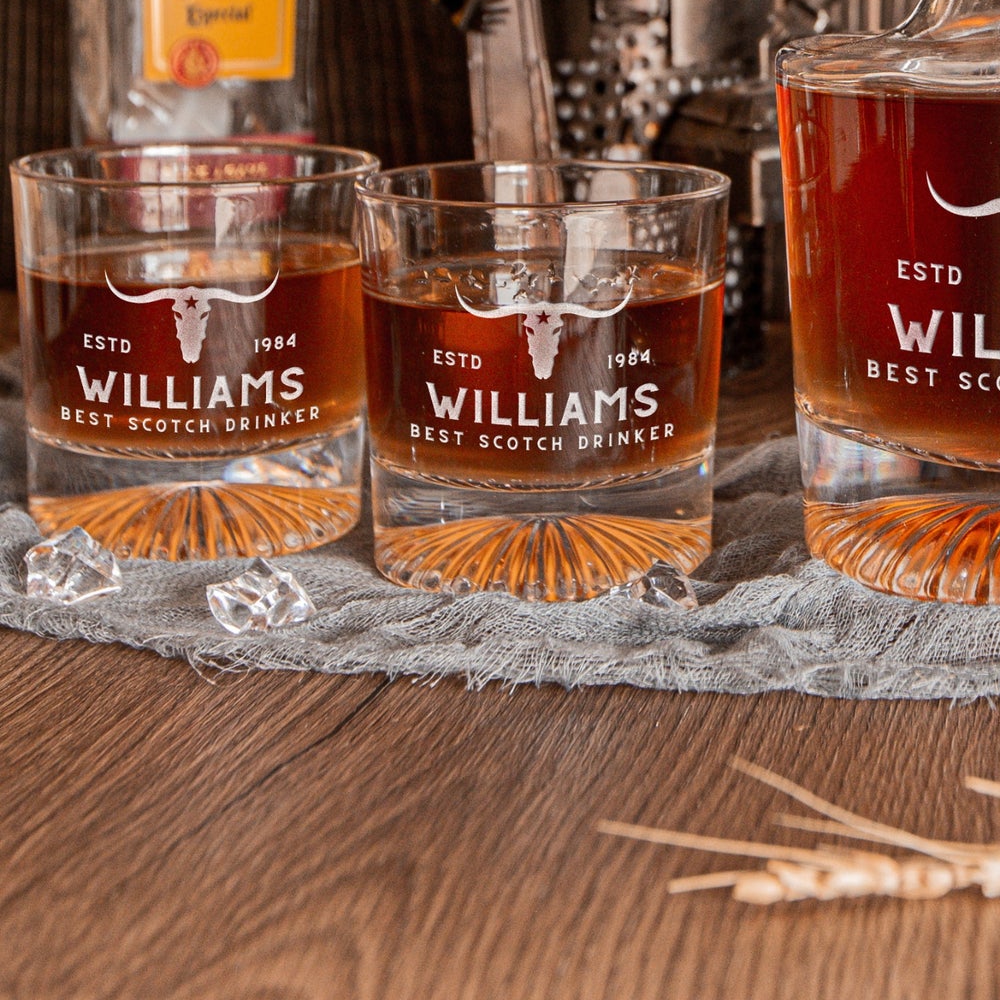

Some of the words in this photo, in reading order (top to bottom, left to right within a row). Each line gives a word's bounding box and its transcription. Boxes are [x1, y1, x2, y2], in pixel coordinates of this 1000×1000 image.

[187, 4, 252, 27] Especial
[897, 259, 963, 285] ESTD
[84, 333, 131, 354] ESTD
[254, 333, 297, 353] 1984
[433, 349, 482, 369] ESTD
[607, 349, 651, 369] 1984
[867, 359, 938, 387] BEST
[76, 365, 305, 410] WILLIAMS
[425, 381, 660, 427] WILLIAMS
[61, 405, 113, 428] BEST
[128, 418, 211, 433] SCOTCH
[225, 406, 320, 432] DRINKER
[410, 423, 464, 445] BEST
[479, 434, 563, 450] SCOTCH
[578, 423, 675, 450] DRINKER
